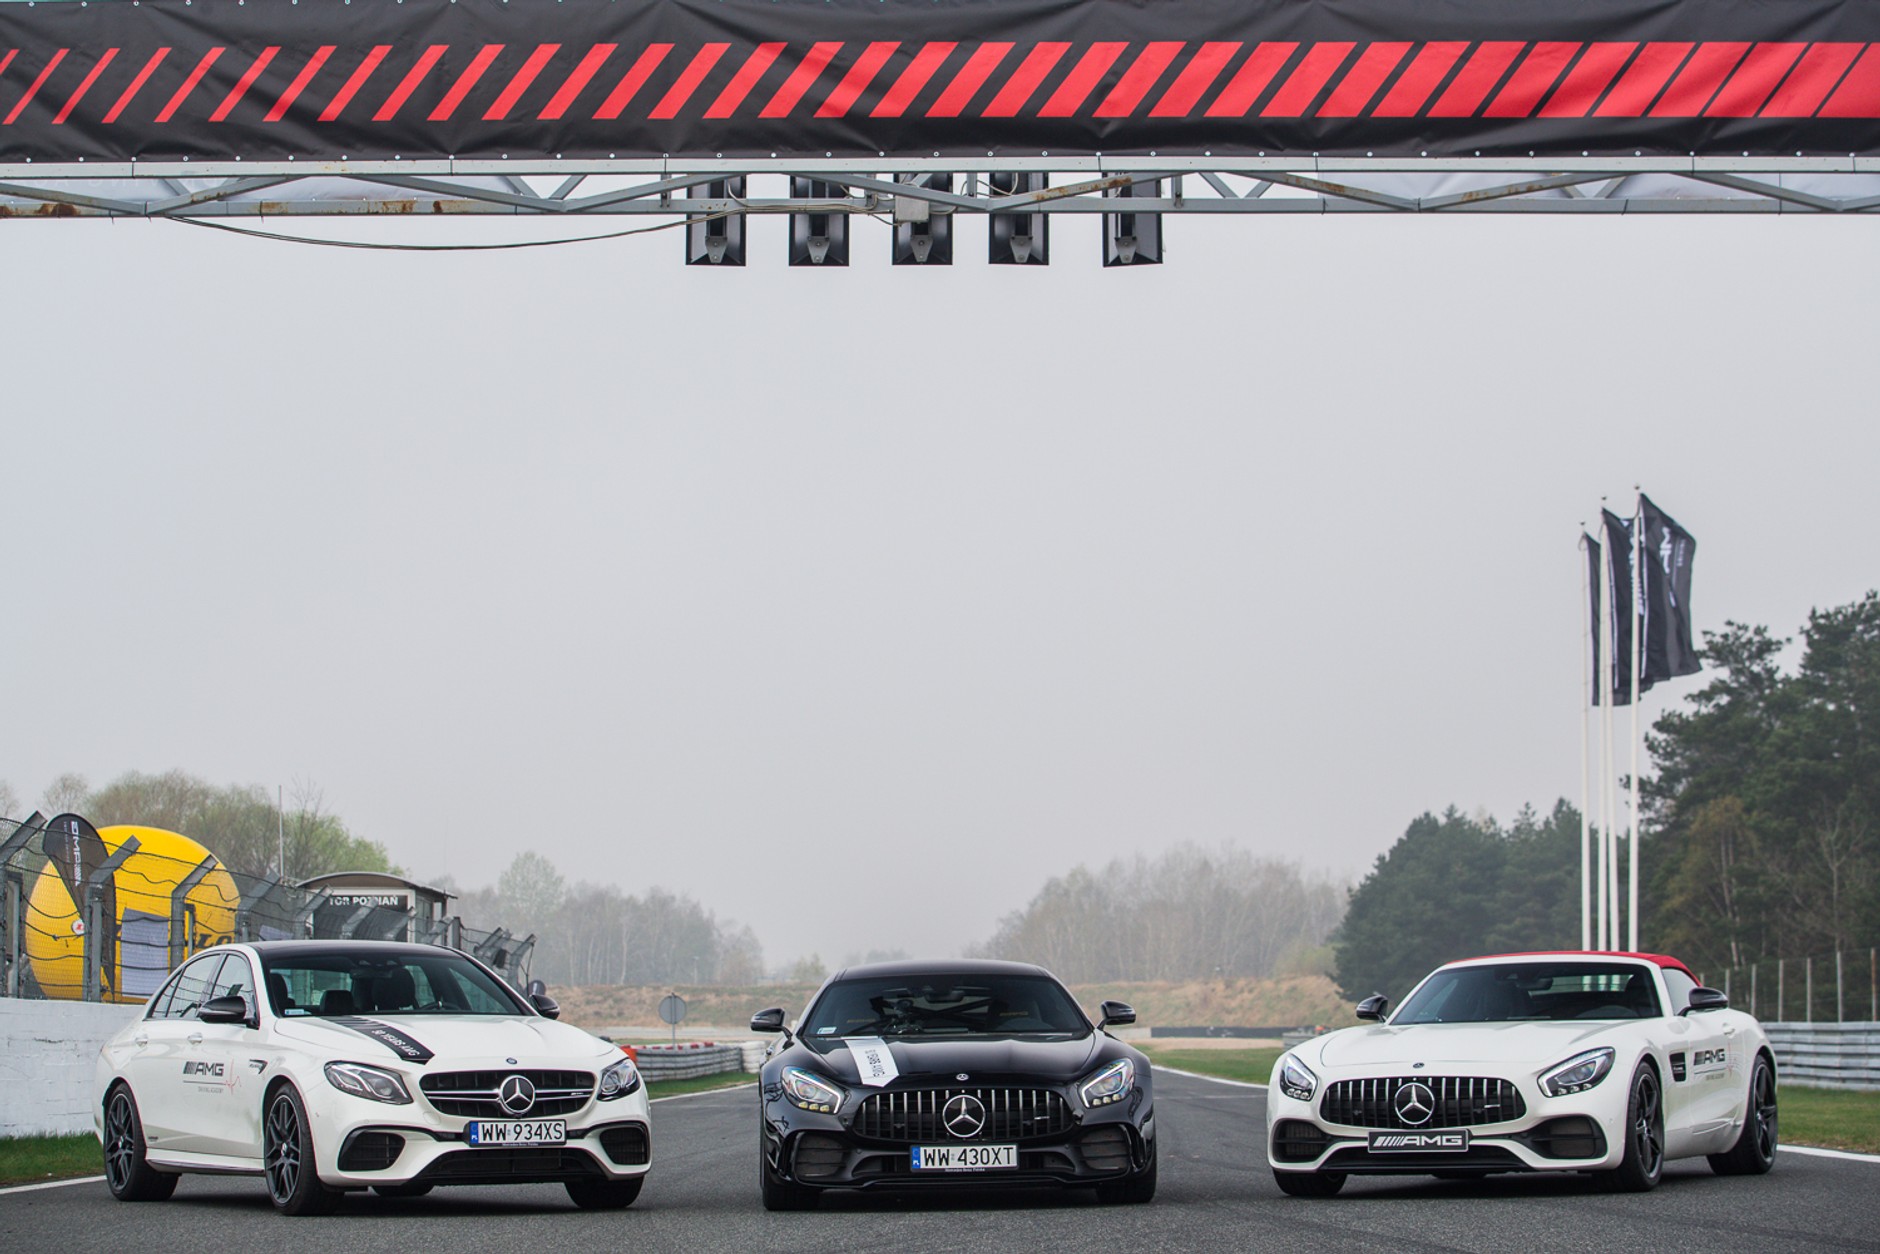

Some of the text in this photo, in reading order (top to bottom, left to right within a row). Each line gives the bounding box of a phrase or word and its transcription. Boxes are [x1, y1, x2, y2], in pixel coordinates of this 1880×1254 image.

[1704, 1048, 1726, 1064] AMG
[194, 1062, 225, 1076] AMG
[482, 1124, 507, 1141] WW
[513, 1123, 563, 1141] 934XS
[1400, 1135, 1463, 1146] AMG
[923, 1148, 950, 1166] WW
[957, 1147, 1014, 1166] 430XT
